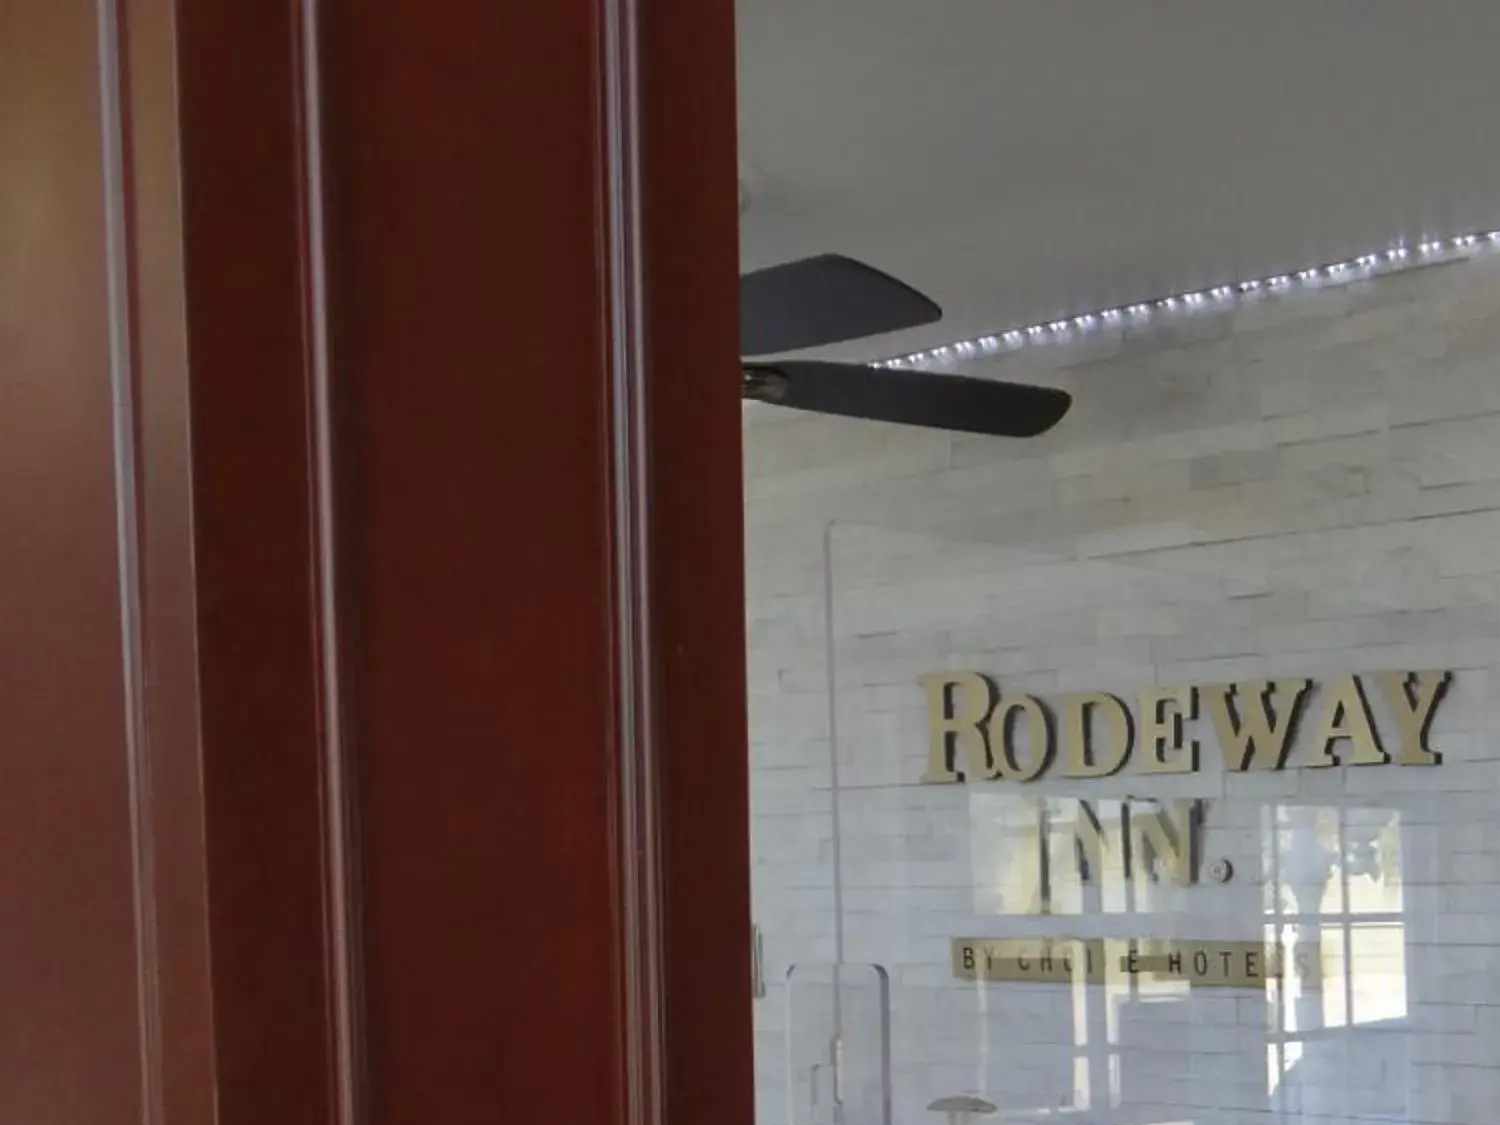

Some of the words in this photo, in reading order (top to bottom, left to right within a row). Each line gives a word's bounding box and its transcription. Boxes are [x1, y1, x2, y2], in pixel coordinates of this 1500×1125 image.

[919, 669, 1454, 784] RODEWAY
[962, 946, 996, 972] BY
[1017, 945, 1140, 974] CHOIE
[1168, 950, 1312, 980] HOTES
